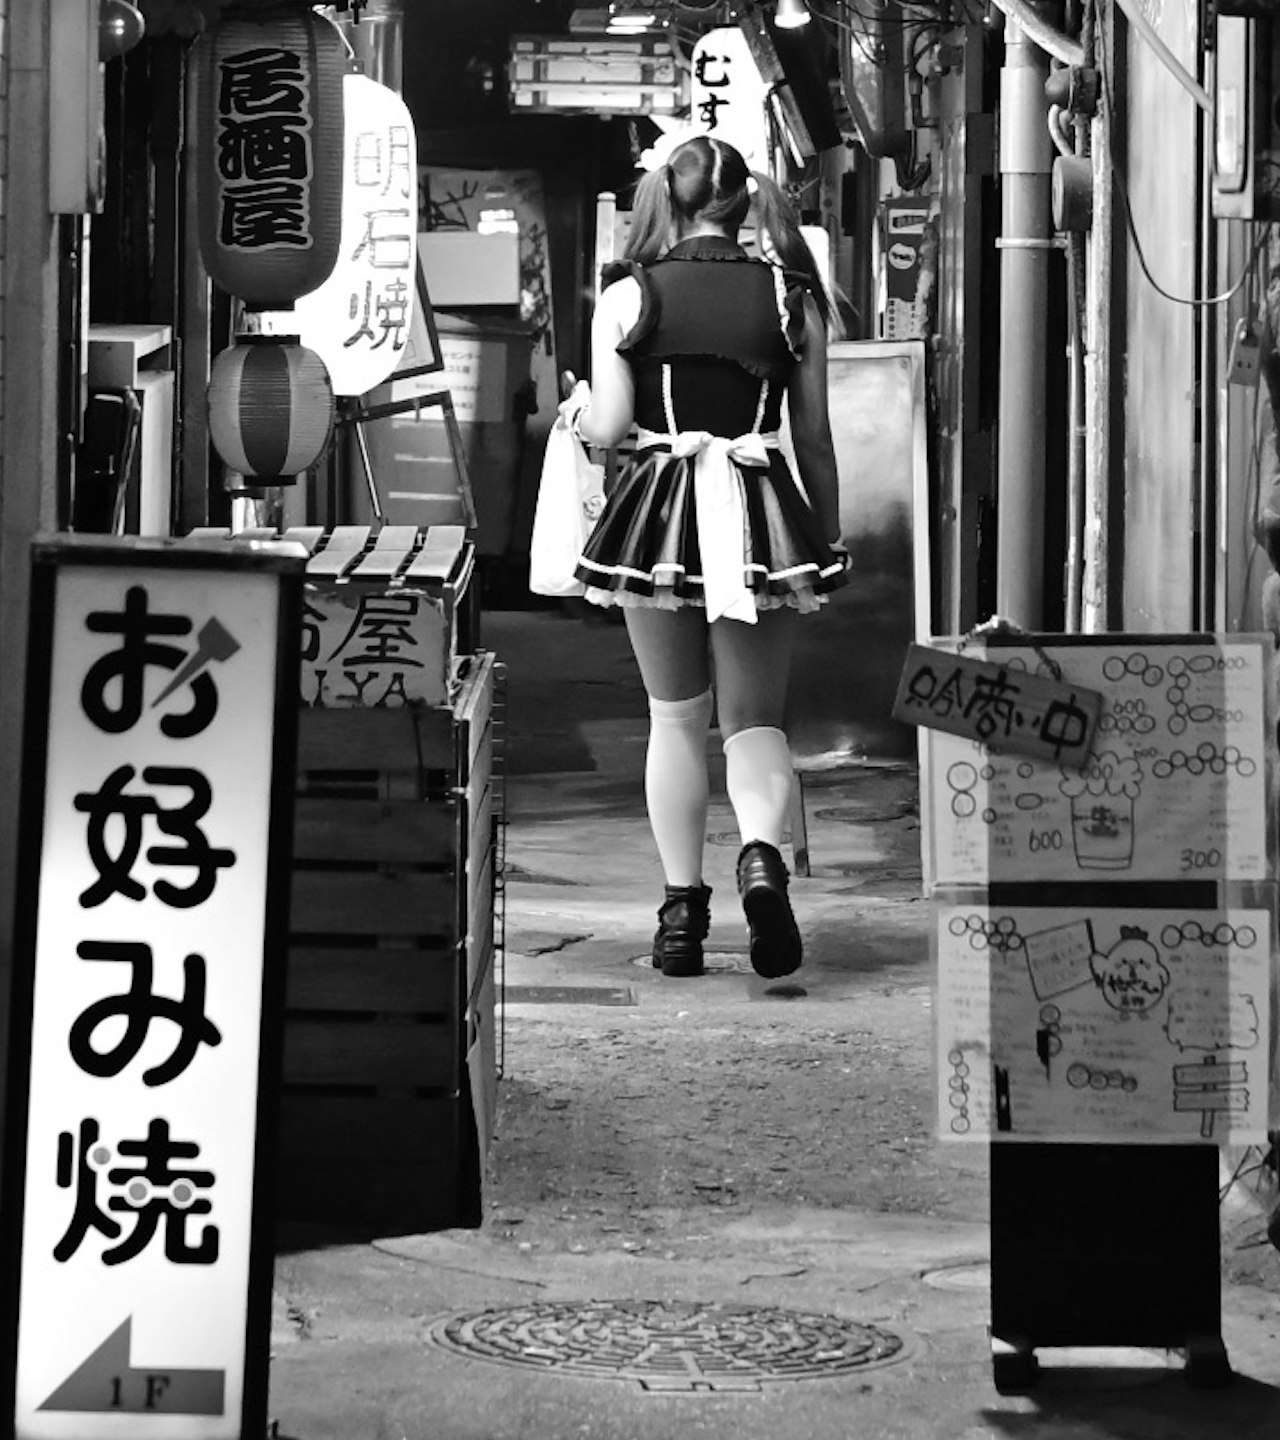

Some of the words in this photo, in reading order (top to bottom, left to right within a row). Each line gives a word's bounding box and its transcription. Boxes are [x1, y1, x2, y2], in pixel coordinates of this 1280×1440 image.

[216, 47, 312, 249] 居酒屋
[342, 124, 412, 352] 明石焼
[51, 583, 235, 1267] お好み焼
[1029, 829, 1062, 852] 600
[1180, 848, 1221, 871] 300
